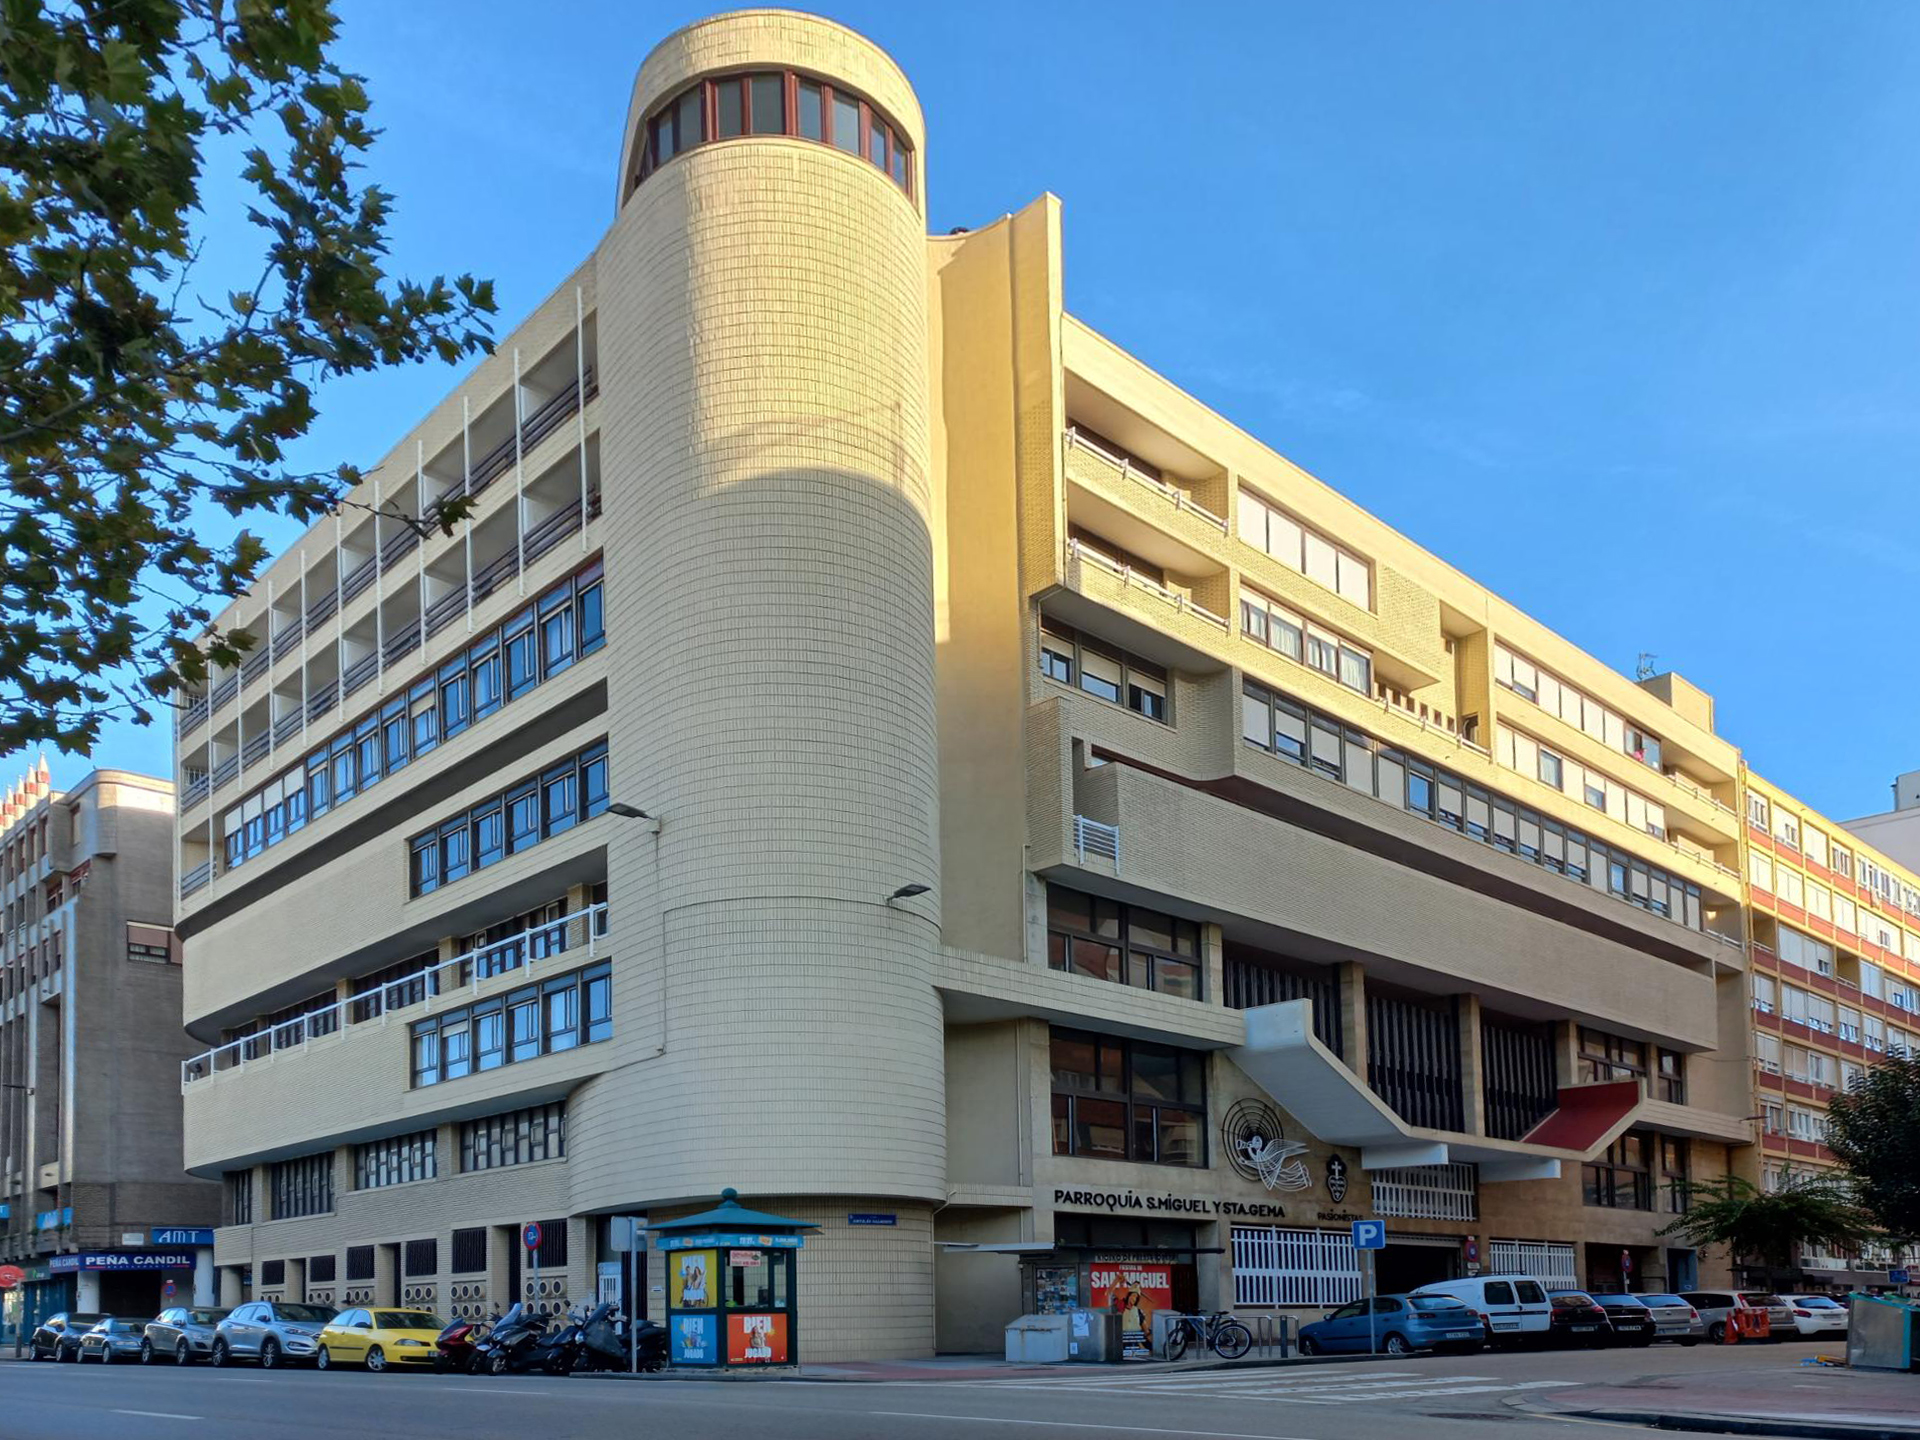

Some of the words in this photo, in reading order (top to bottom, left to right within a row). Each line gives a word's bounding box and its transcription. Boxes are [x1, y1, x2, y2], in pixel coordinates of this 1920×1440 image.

[1317, 1209, 1364, 1221] PASIONISTAS
[158, 1230, 199, 1243] AMT
[1359, 1224, 1378, 1246] P
[85, 1254, 129, 1265] PEÑA
[133, 1255, 190, 1265] CANDIL
[743, 1315, 772, 1334] BIEN
